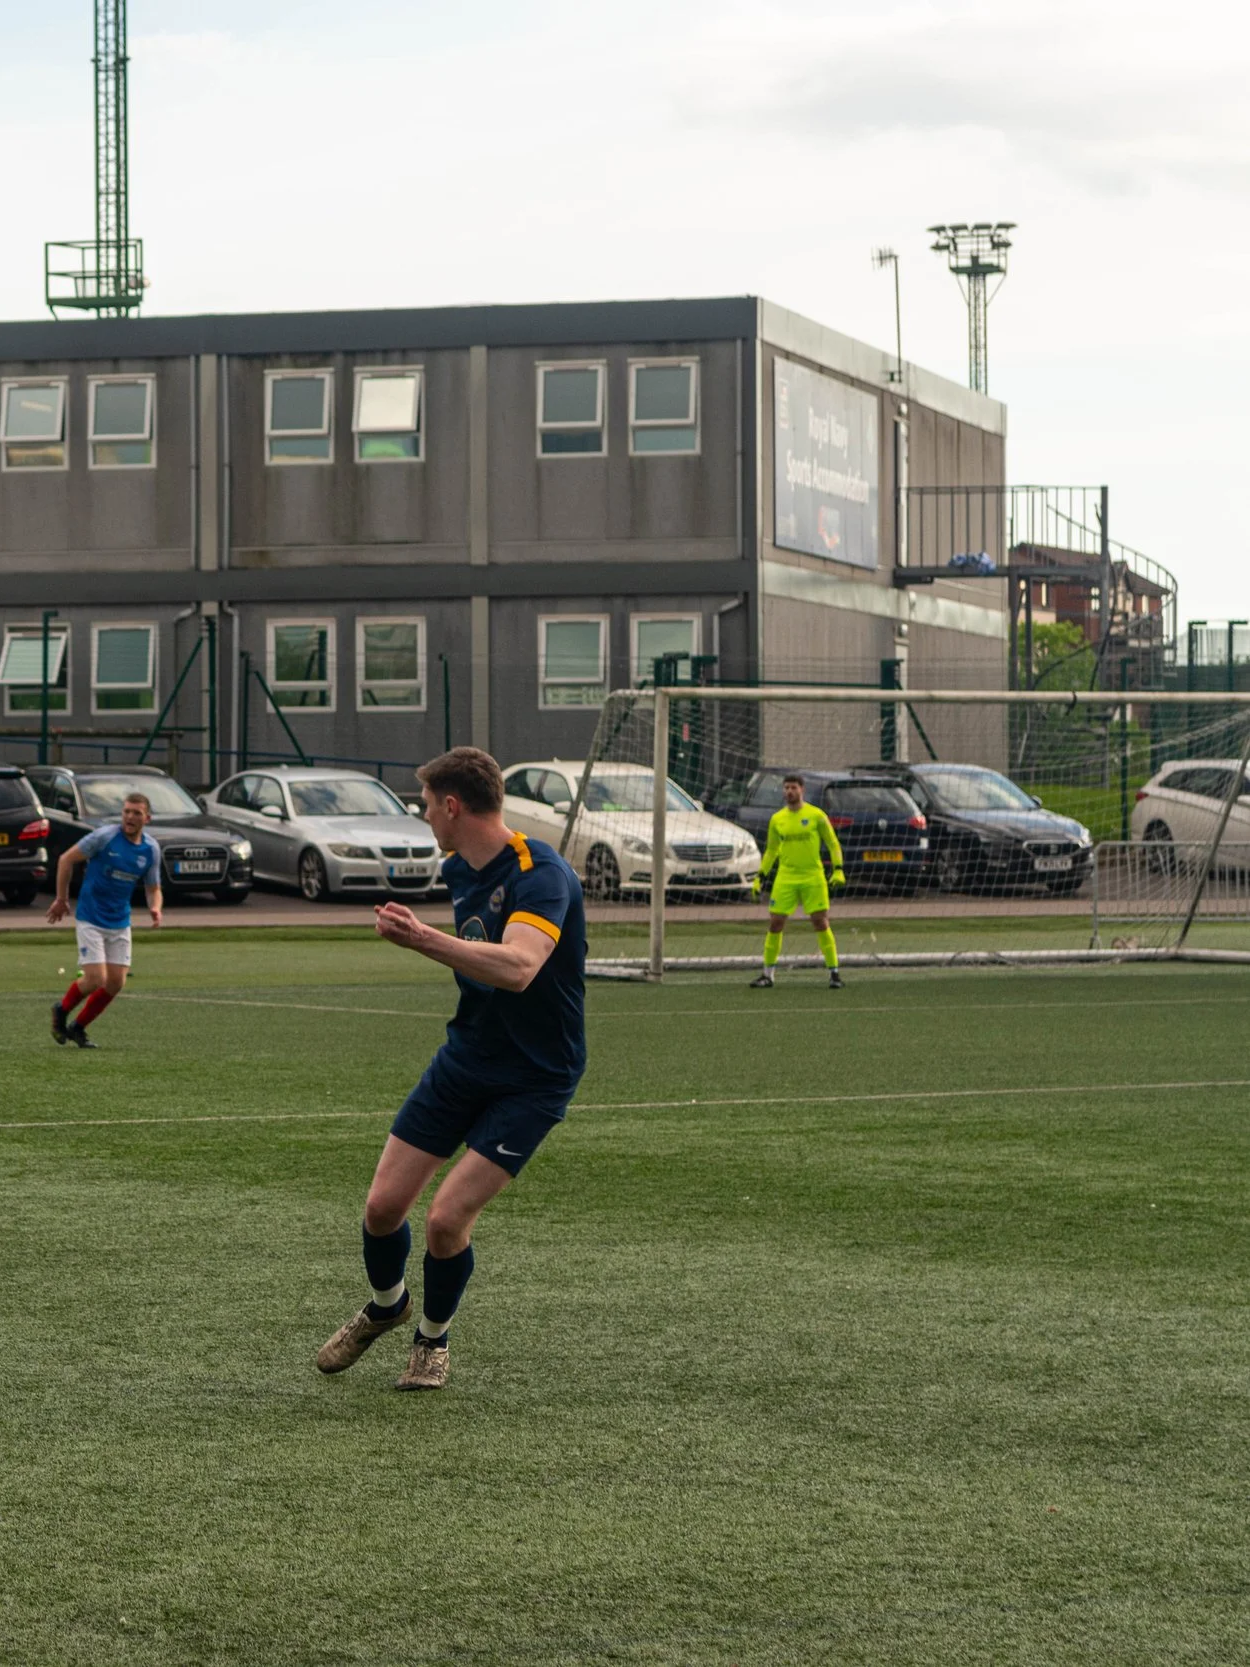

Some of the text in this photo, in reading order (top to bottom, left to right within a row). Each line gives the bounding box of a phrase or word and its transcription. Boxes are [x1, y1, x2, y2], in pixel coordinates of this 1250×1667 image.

[809, 405, 848, 459] Royal Navy
[786, 449, 869, 504] Sports Accommodation
